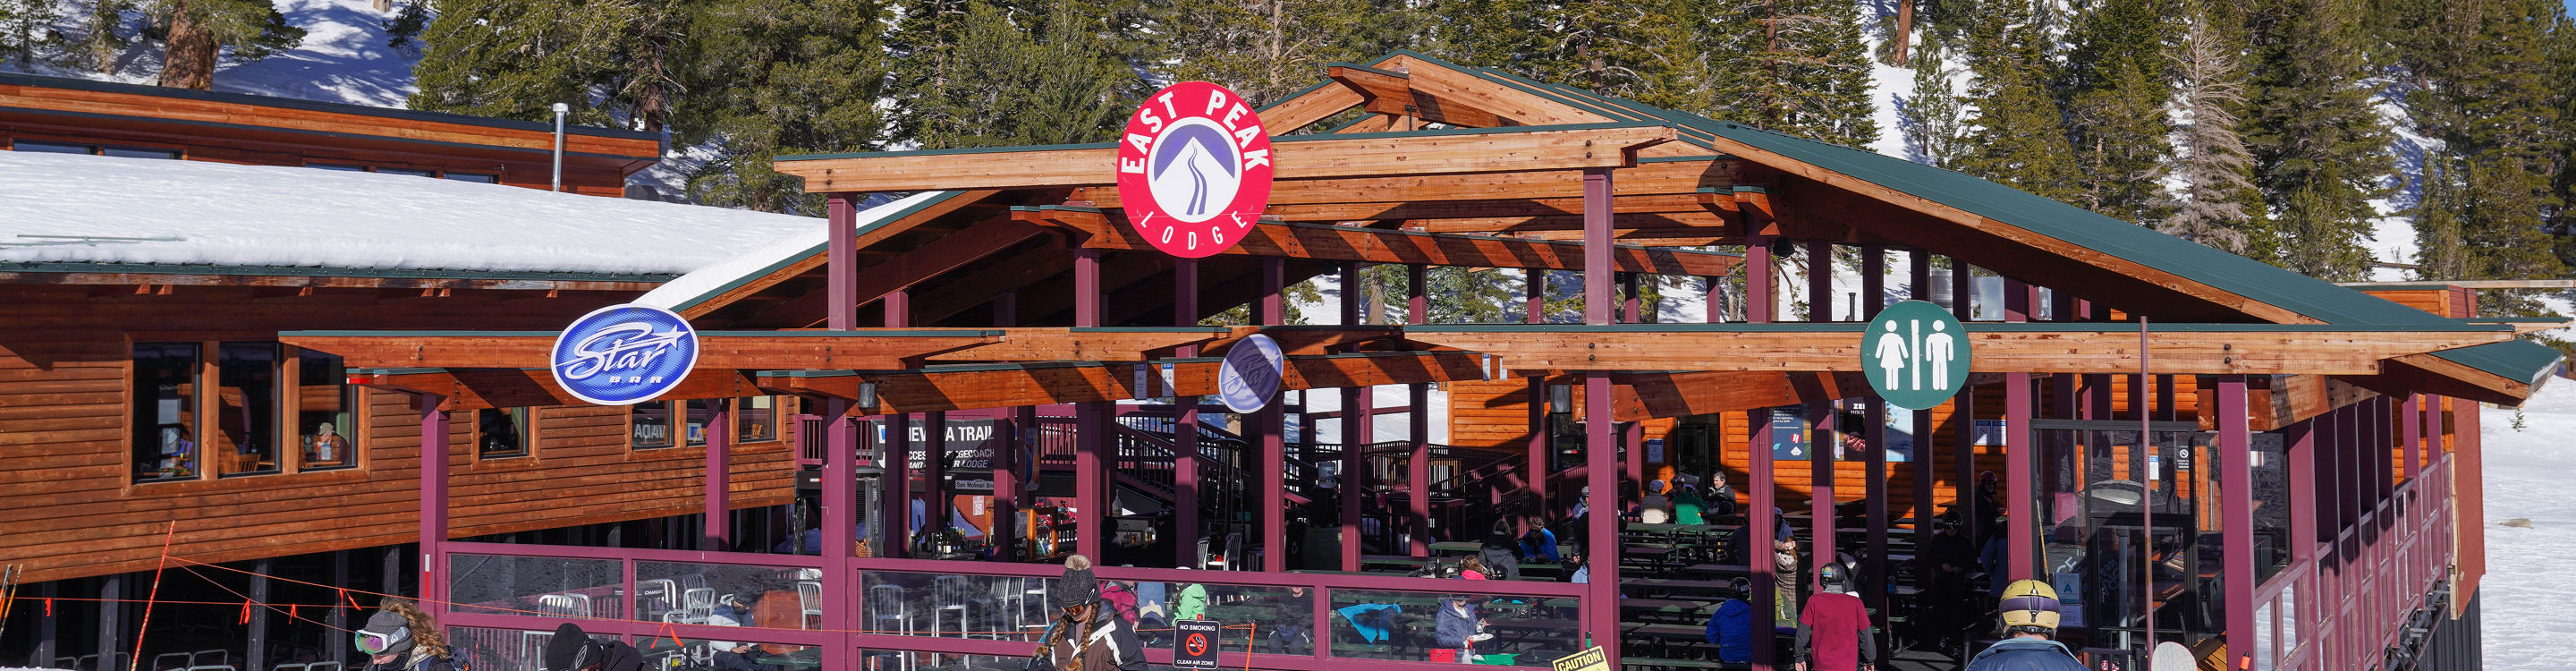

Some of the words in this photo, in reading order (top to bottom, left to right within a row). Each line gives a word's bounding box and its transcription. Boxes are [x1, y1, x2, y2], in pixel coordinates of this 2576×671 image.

[1121, 91, 1177, 174] EAST
[1205, 89, 1269, 172] PEAK
[1140, 210, 1247, 251] LODGE
[556, 322, 687, 379] Star
[609, 376, 663, 384] BAR
[962, 459, 988, 469] LODGE
[2063, 583, 2072, 593] A
[1558, 650, 1602, 671] CAUTION
